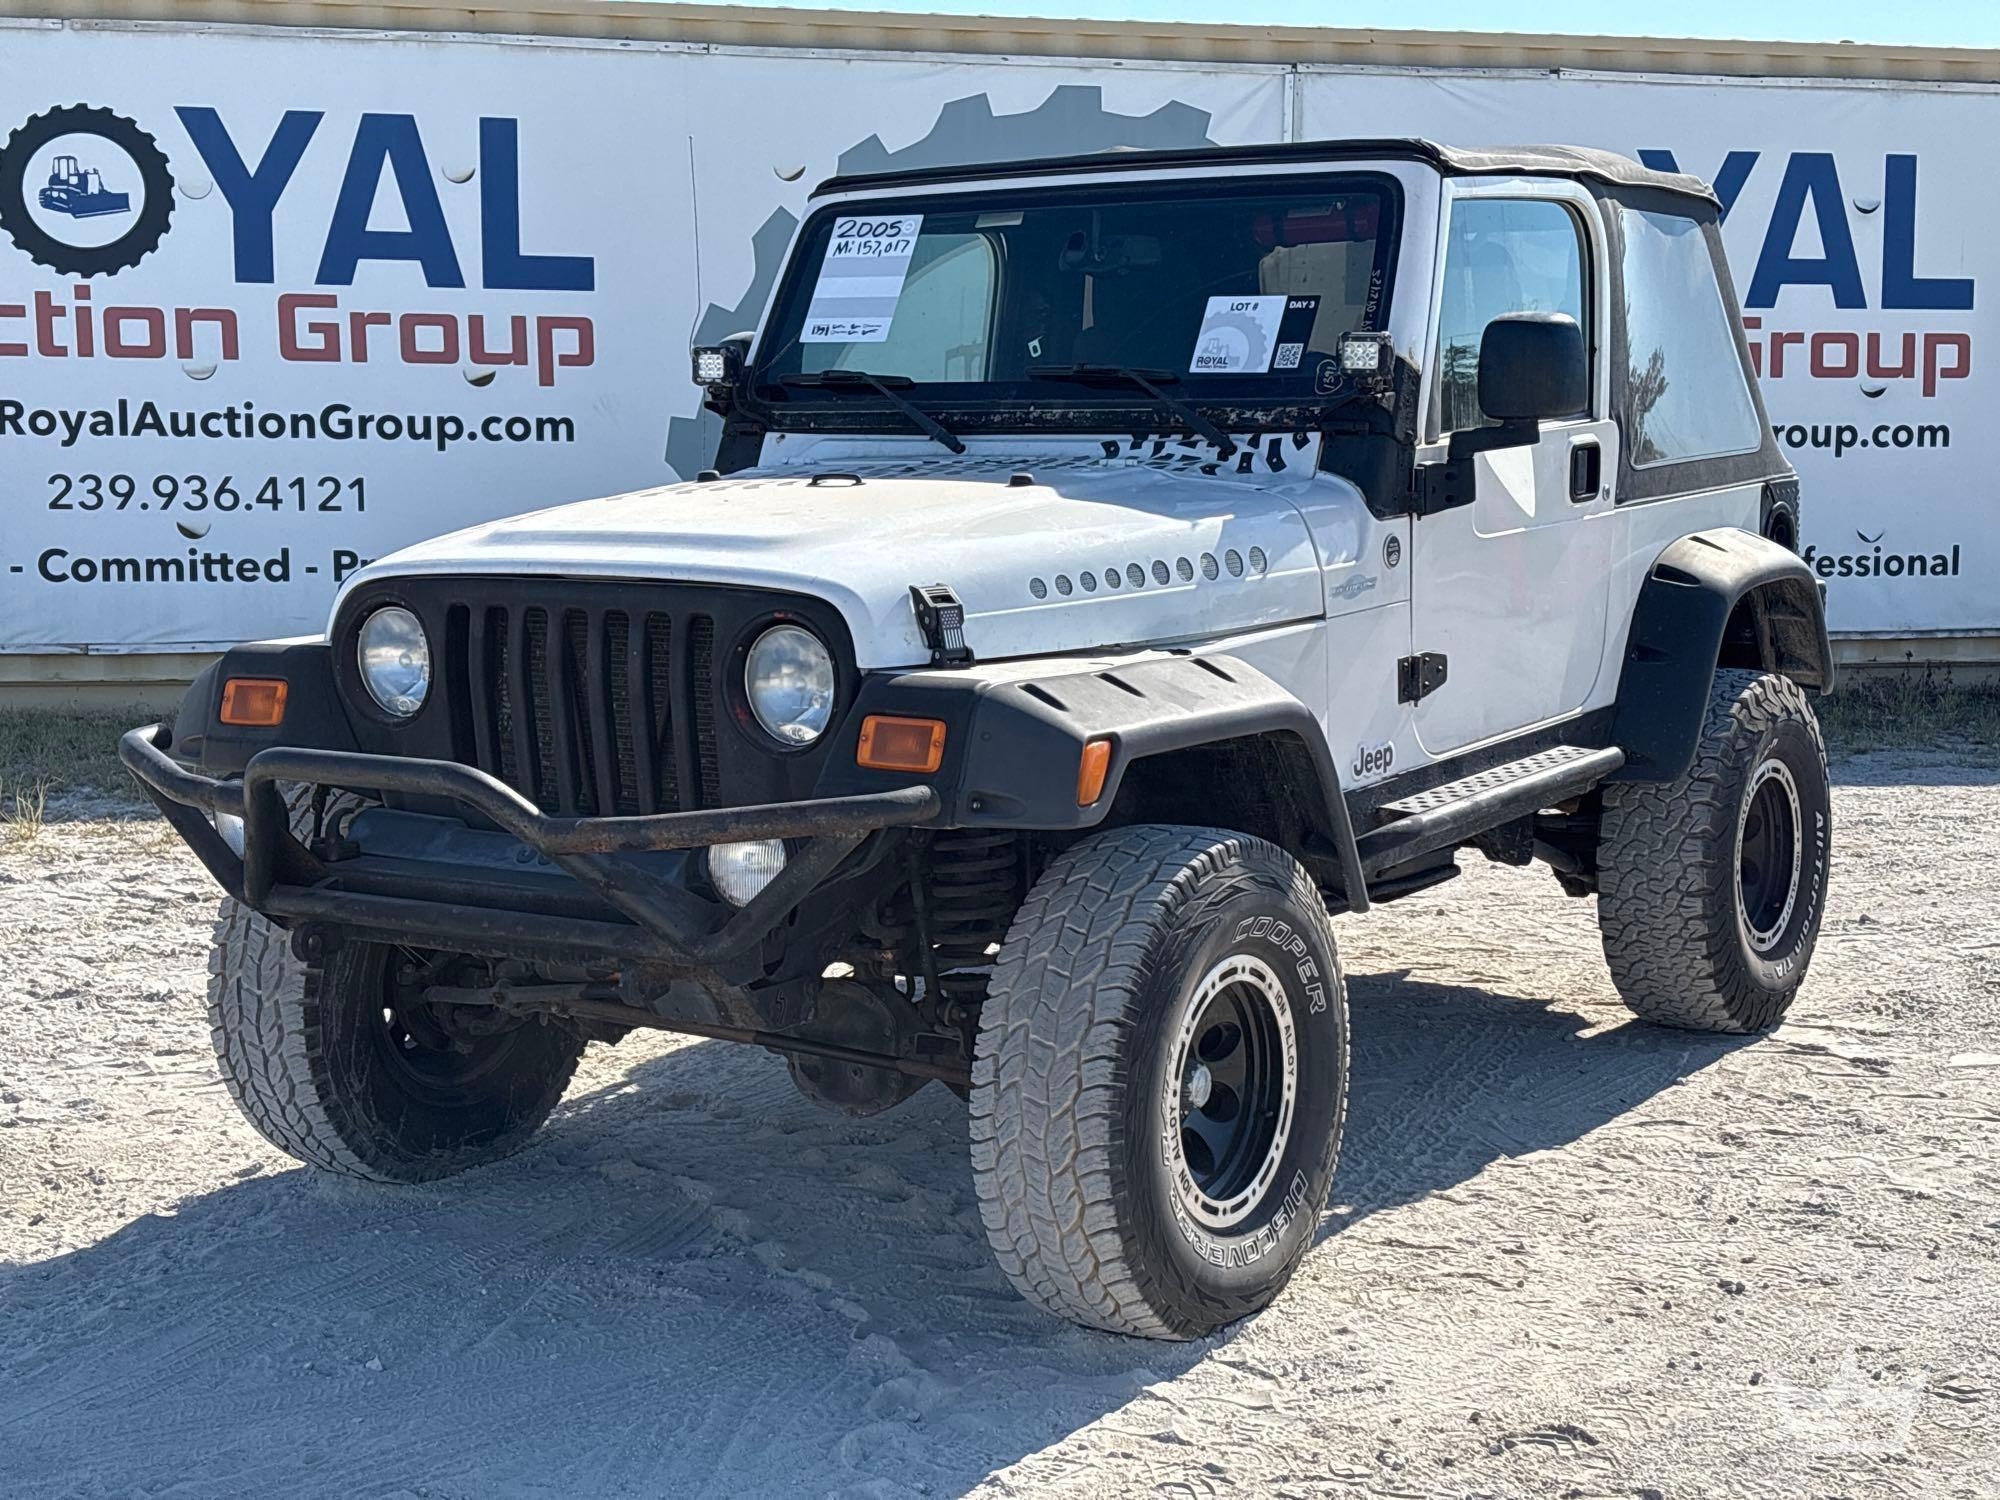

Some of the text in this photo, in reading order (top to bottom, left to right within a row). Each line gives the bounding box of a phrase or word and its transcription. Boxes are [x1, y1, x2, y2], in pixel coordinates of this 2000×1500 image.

[836, 219, 903, 238] 2005
[1230, 302, 1251, 312] LOT
[1288, 300, 1316, 309] DAY 3
[277, 293, 595, 387] Group
[1197, 356, 1229, 366] ROYAL
[0, 398, 576, 451] RoyalAuctionGroup.com
[47, 474, 367, 513] 239.936.4121
[38, 548, 291, 583] Committed
[1353, 745, 1394, 777] Jeep
[1794, 811, 1824, 956] All-Terrain
[1232, 915, 1326, 1014] COOPER
[1275, 989, 1297, 1078] ION ALLOY
[1169, 1104, 1193, 1196] ION ALLOY
